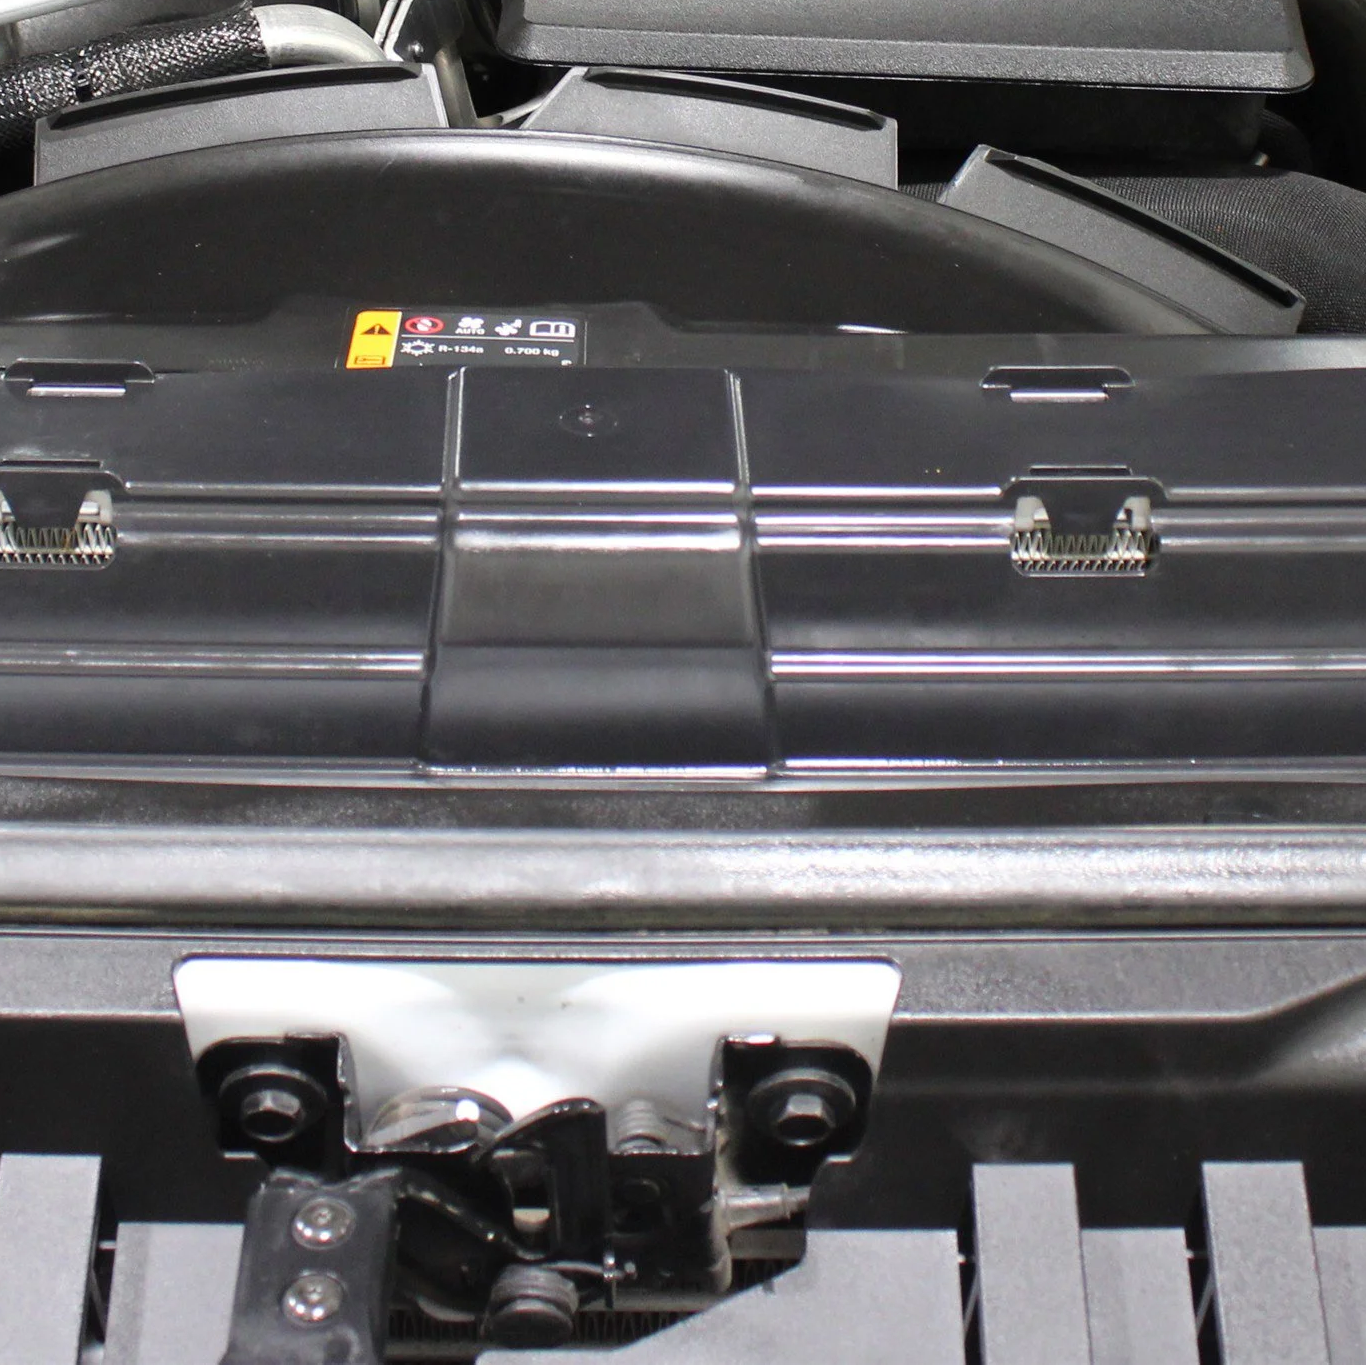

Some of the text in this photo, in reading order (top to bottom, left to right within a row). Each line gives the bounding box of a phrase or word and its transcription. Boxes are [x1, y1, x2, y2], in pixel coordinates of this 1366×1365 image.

[455, 327, 485, 335] AUTO
[438, 344, 484, 353] R-134a
[543, 348, 560, 357] kg
